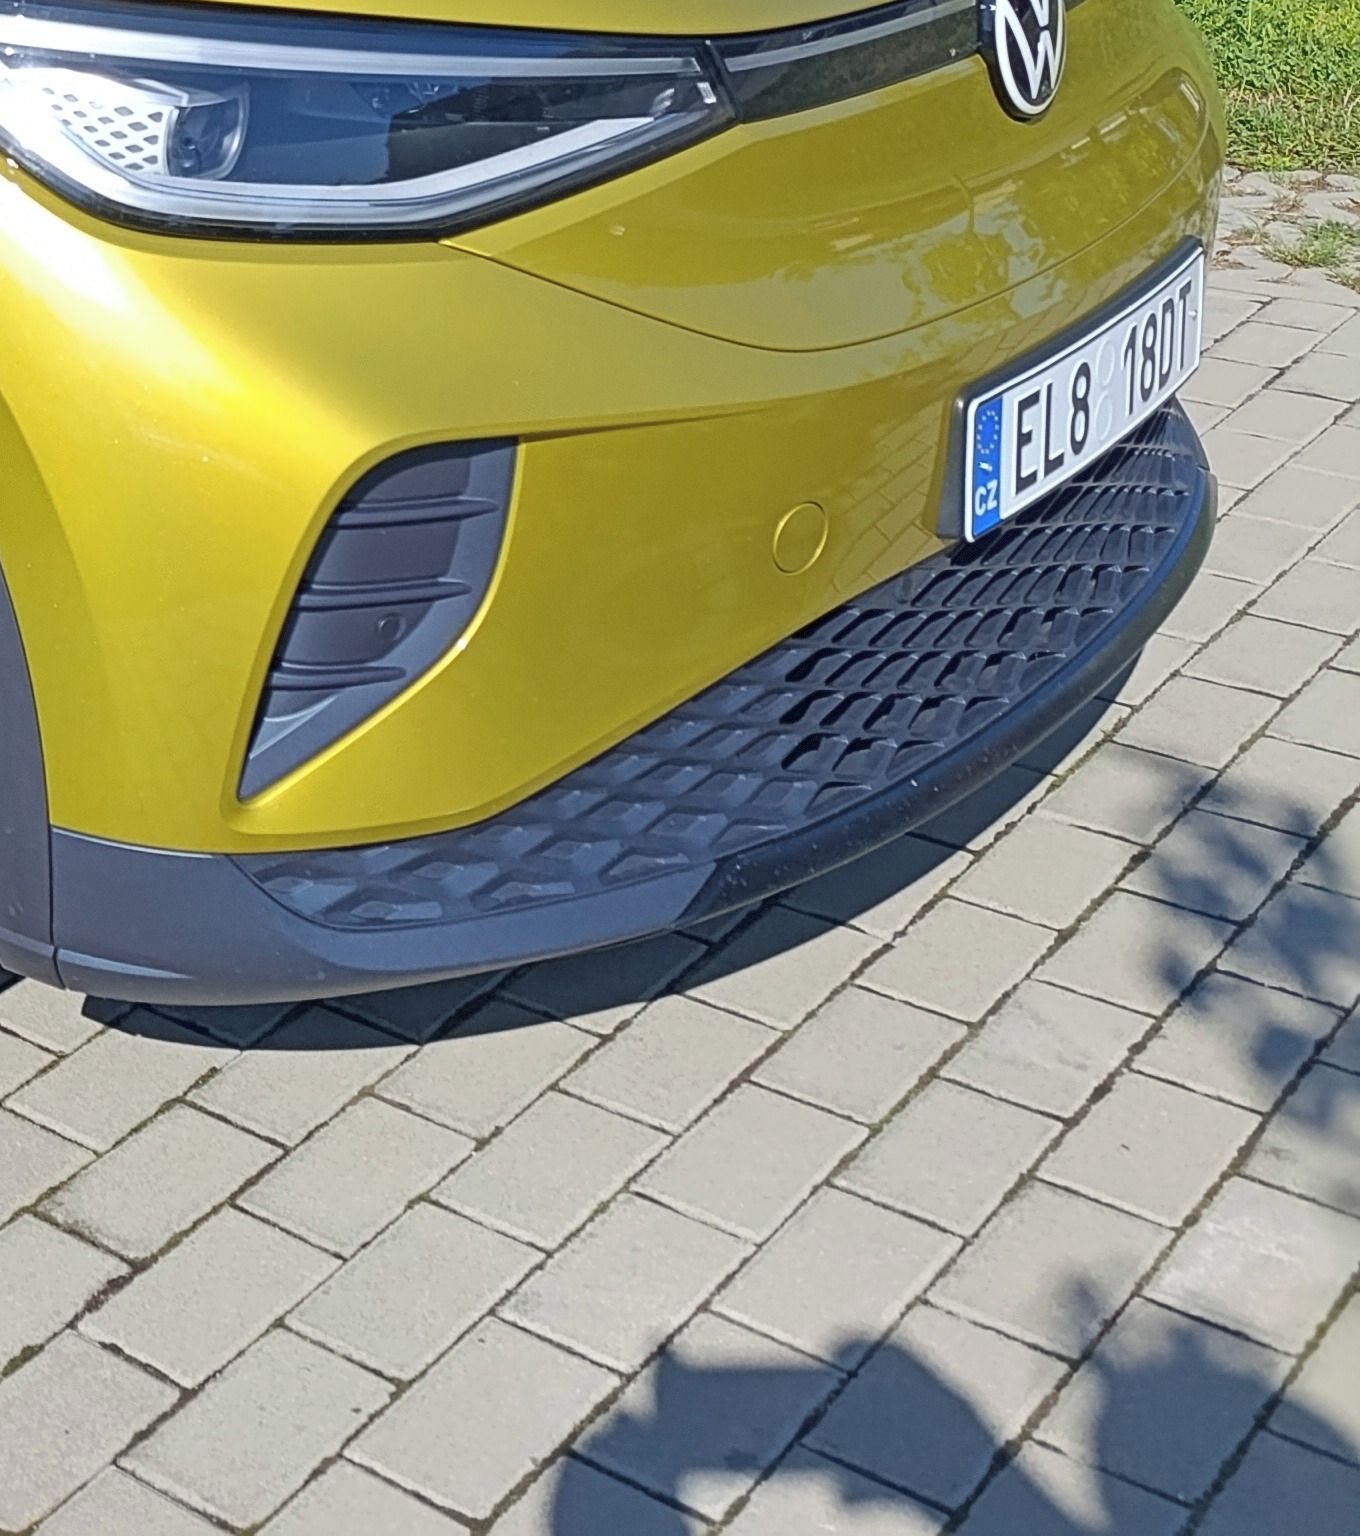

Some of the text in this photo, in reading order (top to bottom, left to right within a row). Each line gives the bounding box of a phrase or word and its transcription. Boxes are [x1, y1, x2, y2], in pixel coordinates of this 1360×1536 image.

[1015, 278, 1193, 496] EL8 18DT
[975, 479, 998, 516] CZ
